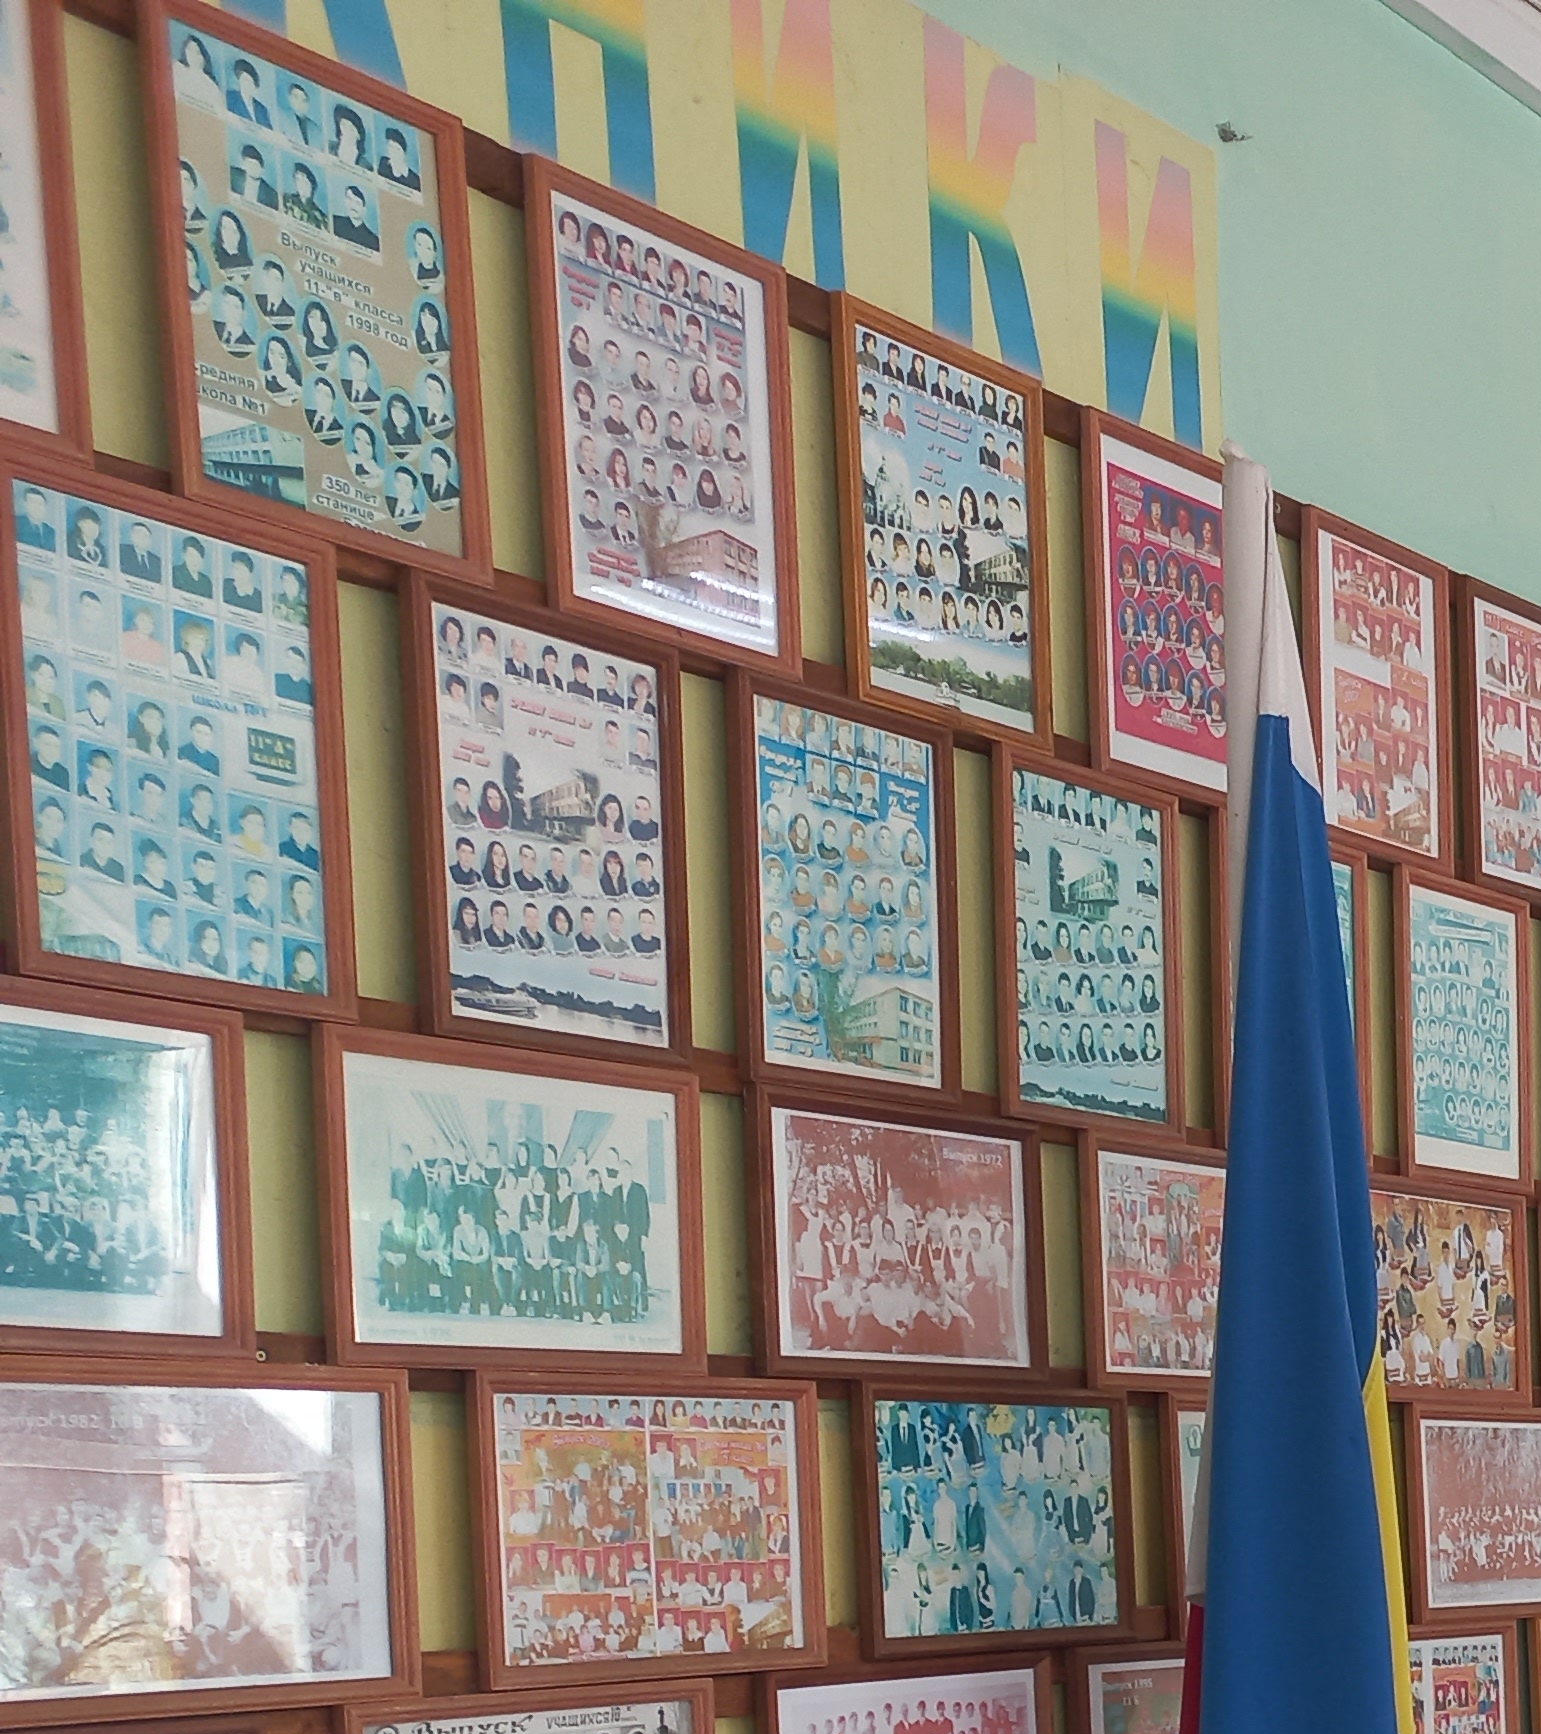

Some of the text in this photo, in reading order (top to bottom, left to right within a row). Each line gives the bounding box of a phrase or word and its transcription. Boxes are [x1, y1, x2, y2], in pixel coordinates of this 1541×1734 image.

[281, 231, 337, 267] Выпуск
[299, 259, 372, 295] учащихся
[354, 299, 404, 326] класса
[348, 313, 409, 349] 1998 год
[195, 361, 256, 391] редняя
[196, 385, 238, 406] кола
[325, 475, 378, 504] 350 лет
[316, 493, 375, 521] станице
[942, 1147, 978, 1166] Выпуск
